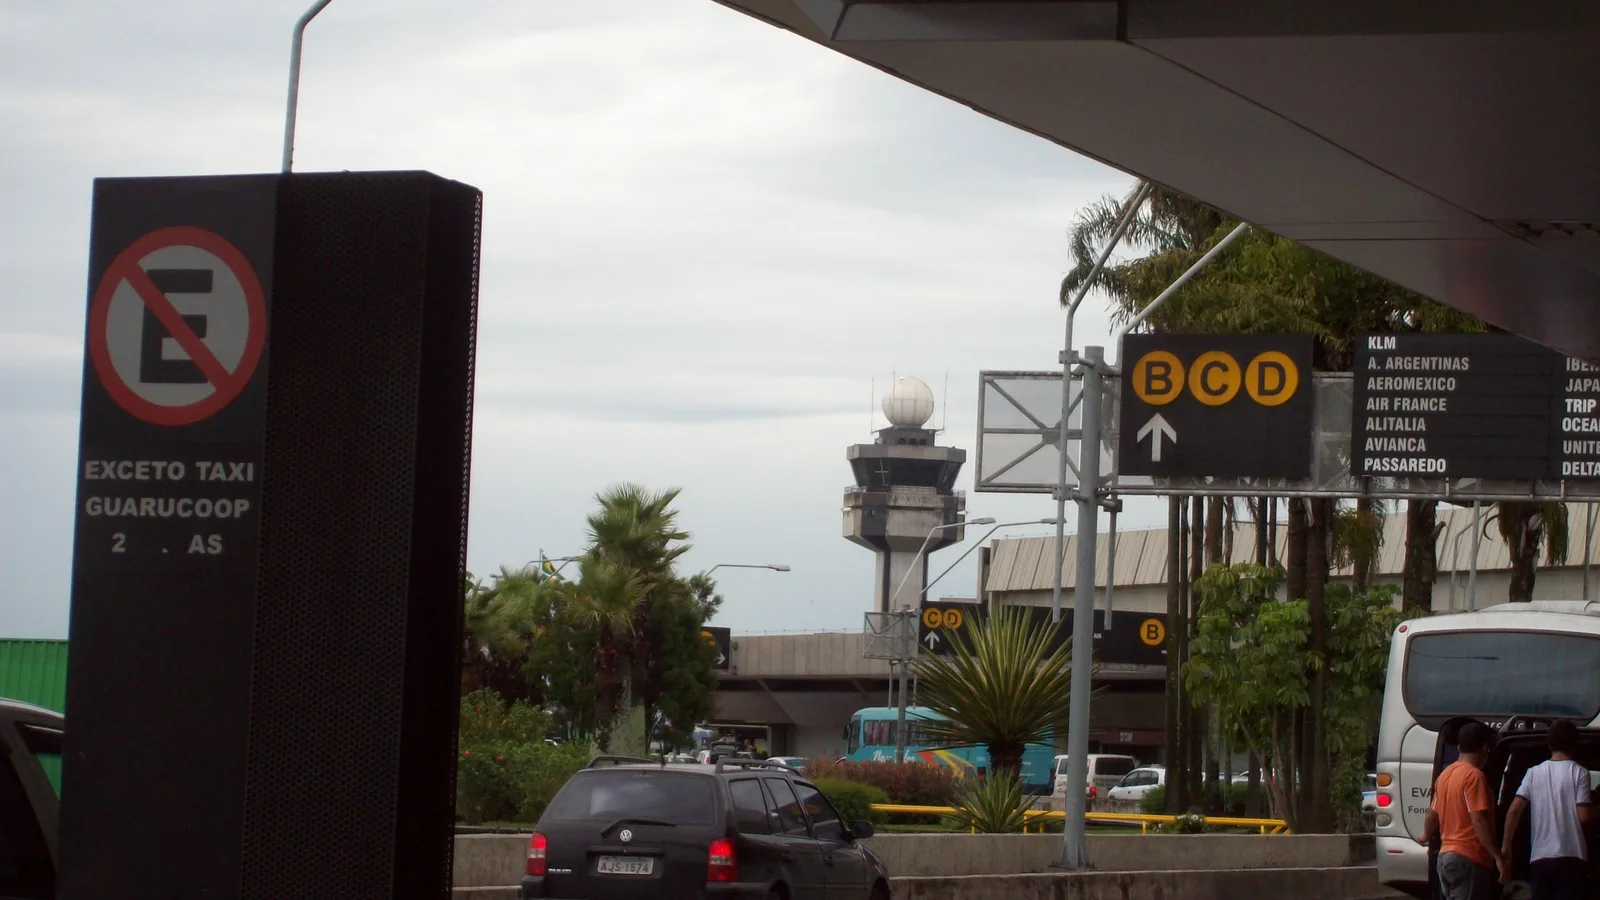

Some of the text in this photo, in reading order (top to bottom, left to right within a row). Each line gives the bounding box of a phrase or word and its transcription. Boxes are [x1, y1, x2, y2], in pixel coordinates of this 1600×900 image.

[1368, 336, 1396, 349] KLM
[1368, 357, 1469, 370] A. ARGENTINAS
[1367, 377, 1456, 391] AEROMEXICO
[1366, 397, 1447, 411] AIR FRANCE
[1565, 399, 1597, 412] TRIP
[1365, 417, 1426, 431] ALITALIA
[1562, 418, 1600, 432] OCEA
[1365, 437, 1426, 452] AVIANCA
[84, 460, 254, 482] EXCETO TAXI
[1364, 457, 1447, 472] PASSAREDO
[1562, 461, 1600, 476] DELTA
[84, 496, 250, 518] GUARUCOOP
[111, 532, 126, 553] 2
